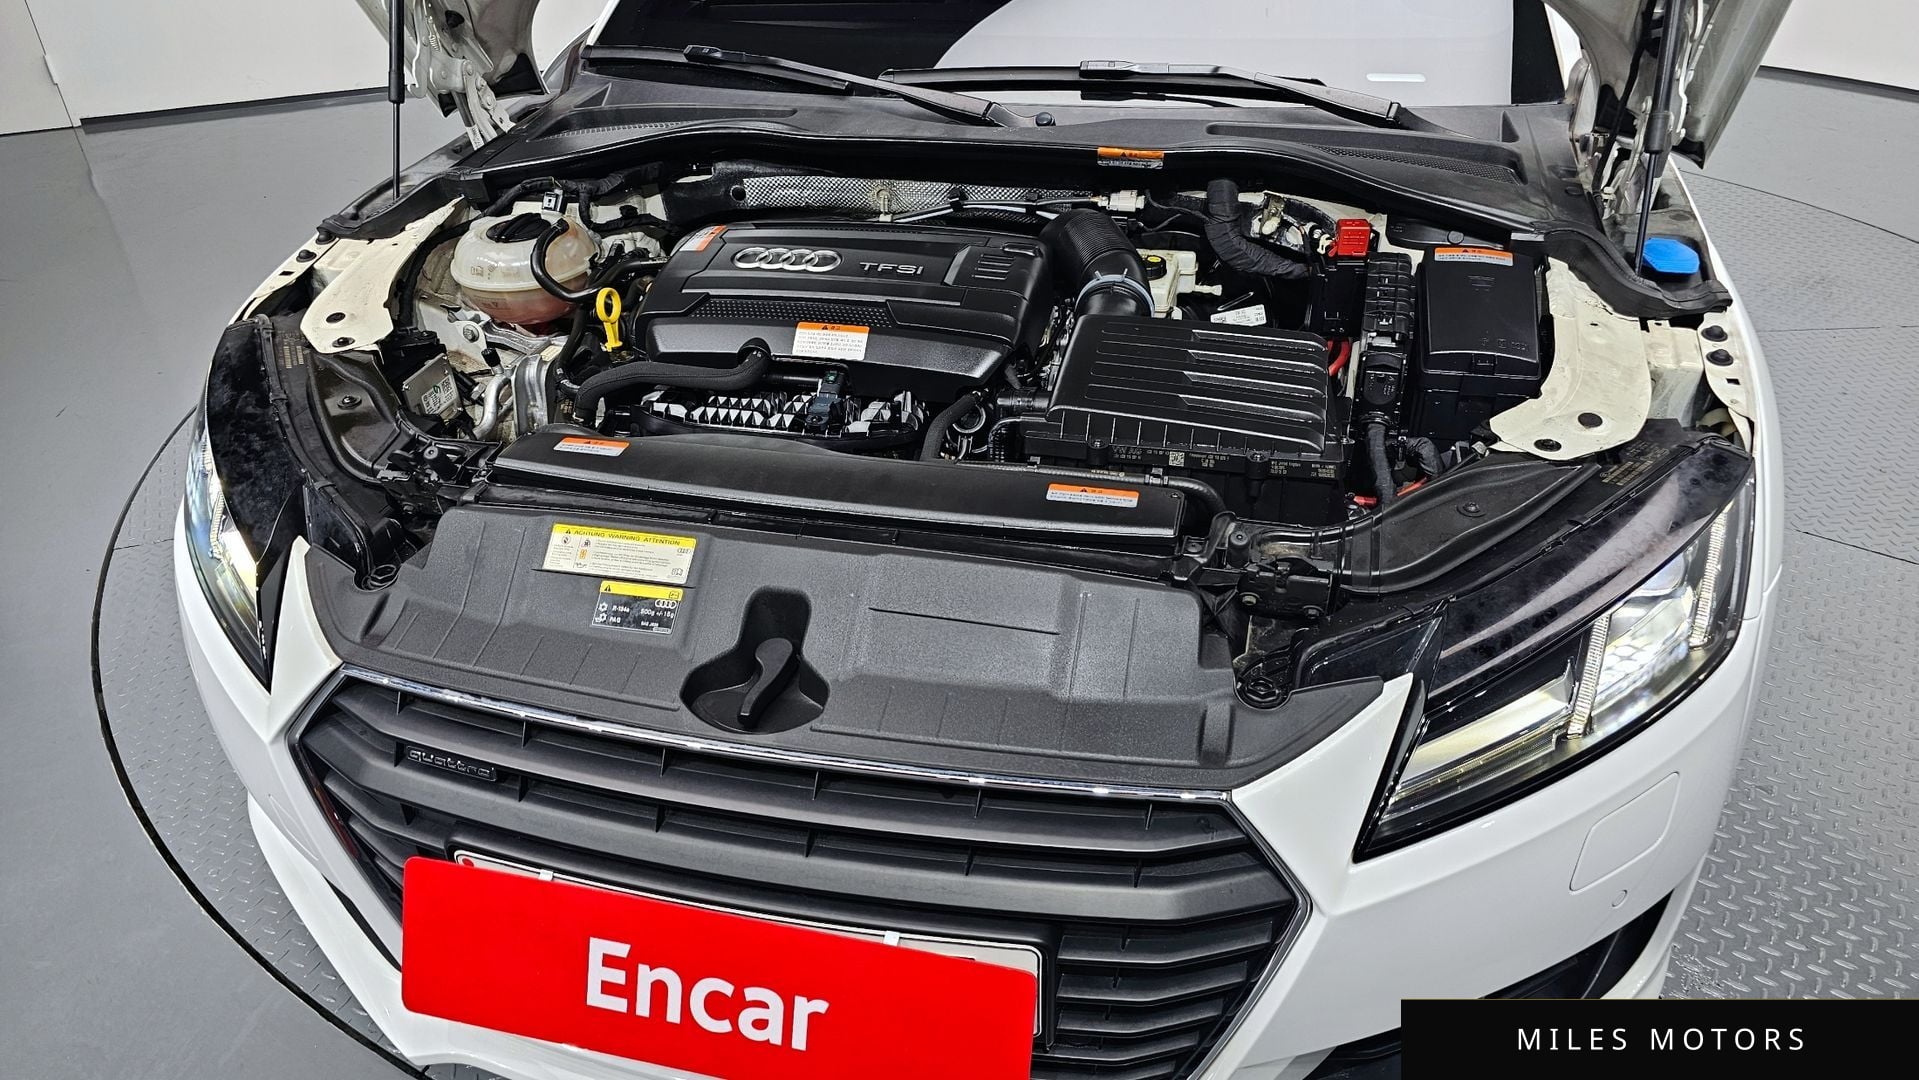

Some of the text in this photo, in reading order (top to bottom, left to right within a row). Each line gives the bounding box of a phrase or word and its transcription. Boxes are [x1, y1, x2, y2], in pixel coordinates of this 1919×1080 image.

[860, 262, 924, 274] TFSI
[574, 529, 681, 546] ACHTUNG WARNING ATTENTION
[409, 750, 490, 777] quattro
[586, 936, 830, 1051] Encar
